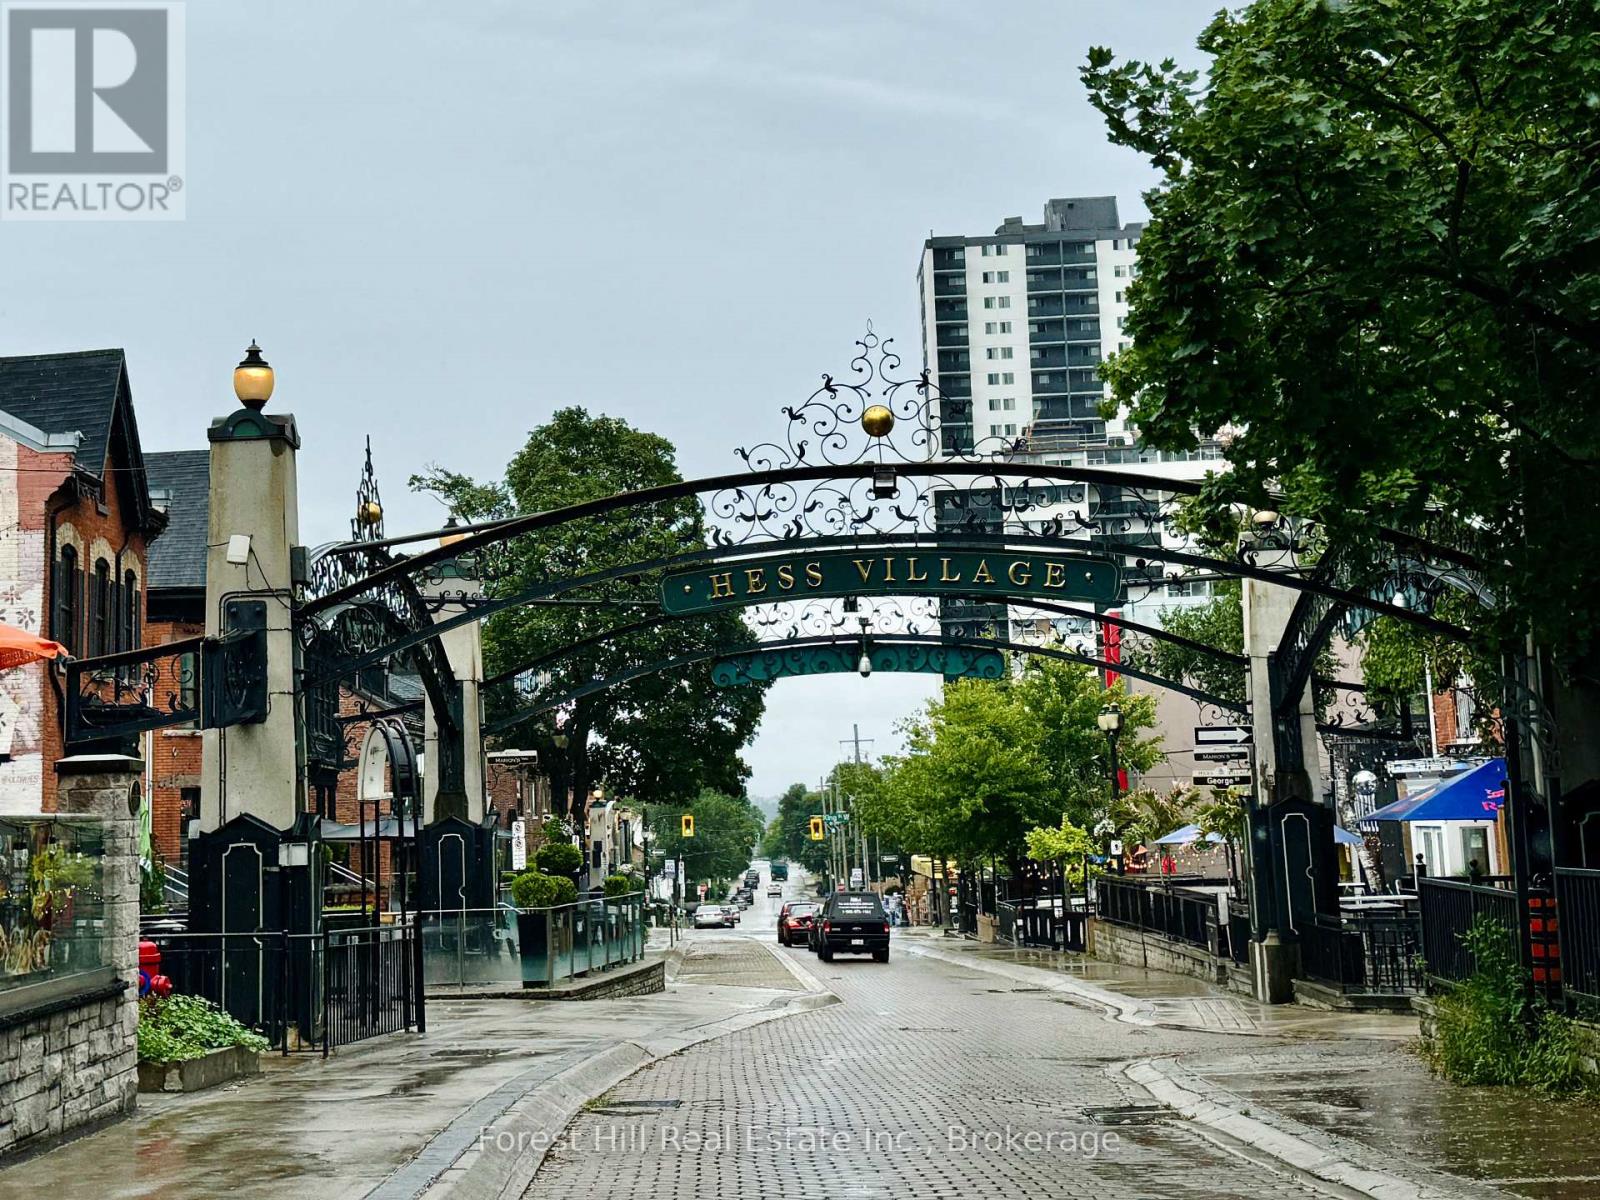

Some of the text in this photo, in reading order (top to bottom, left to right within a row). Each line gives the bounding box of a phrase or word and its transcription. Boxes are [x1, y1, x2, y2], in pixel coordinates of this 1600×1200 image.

[709, 557, 1066, 598] HESS VILLAGE
[1207, 777, 1234, 786] George
